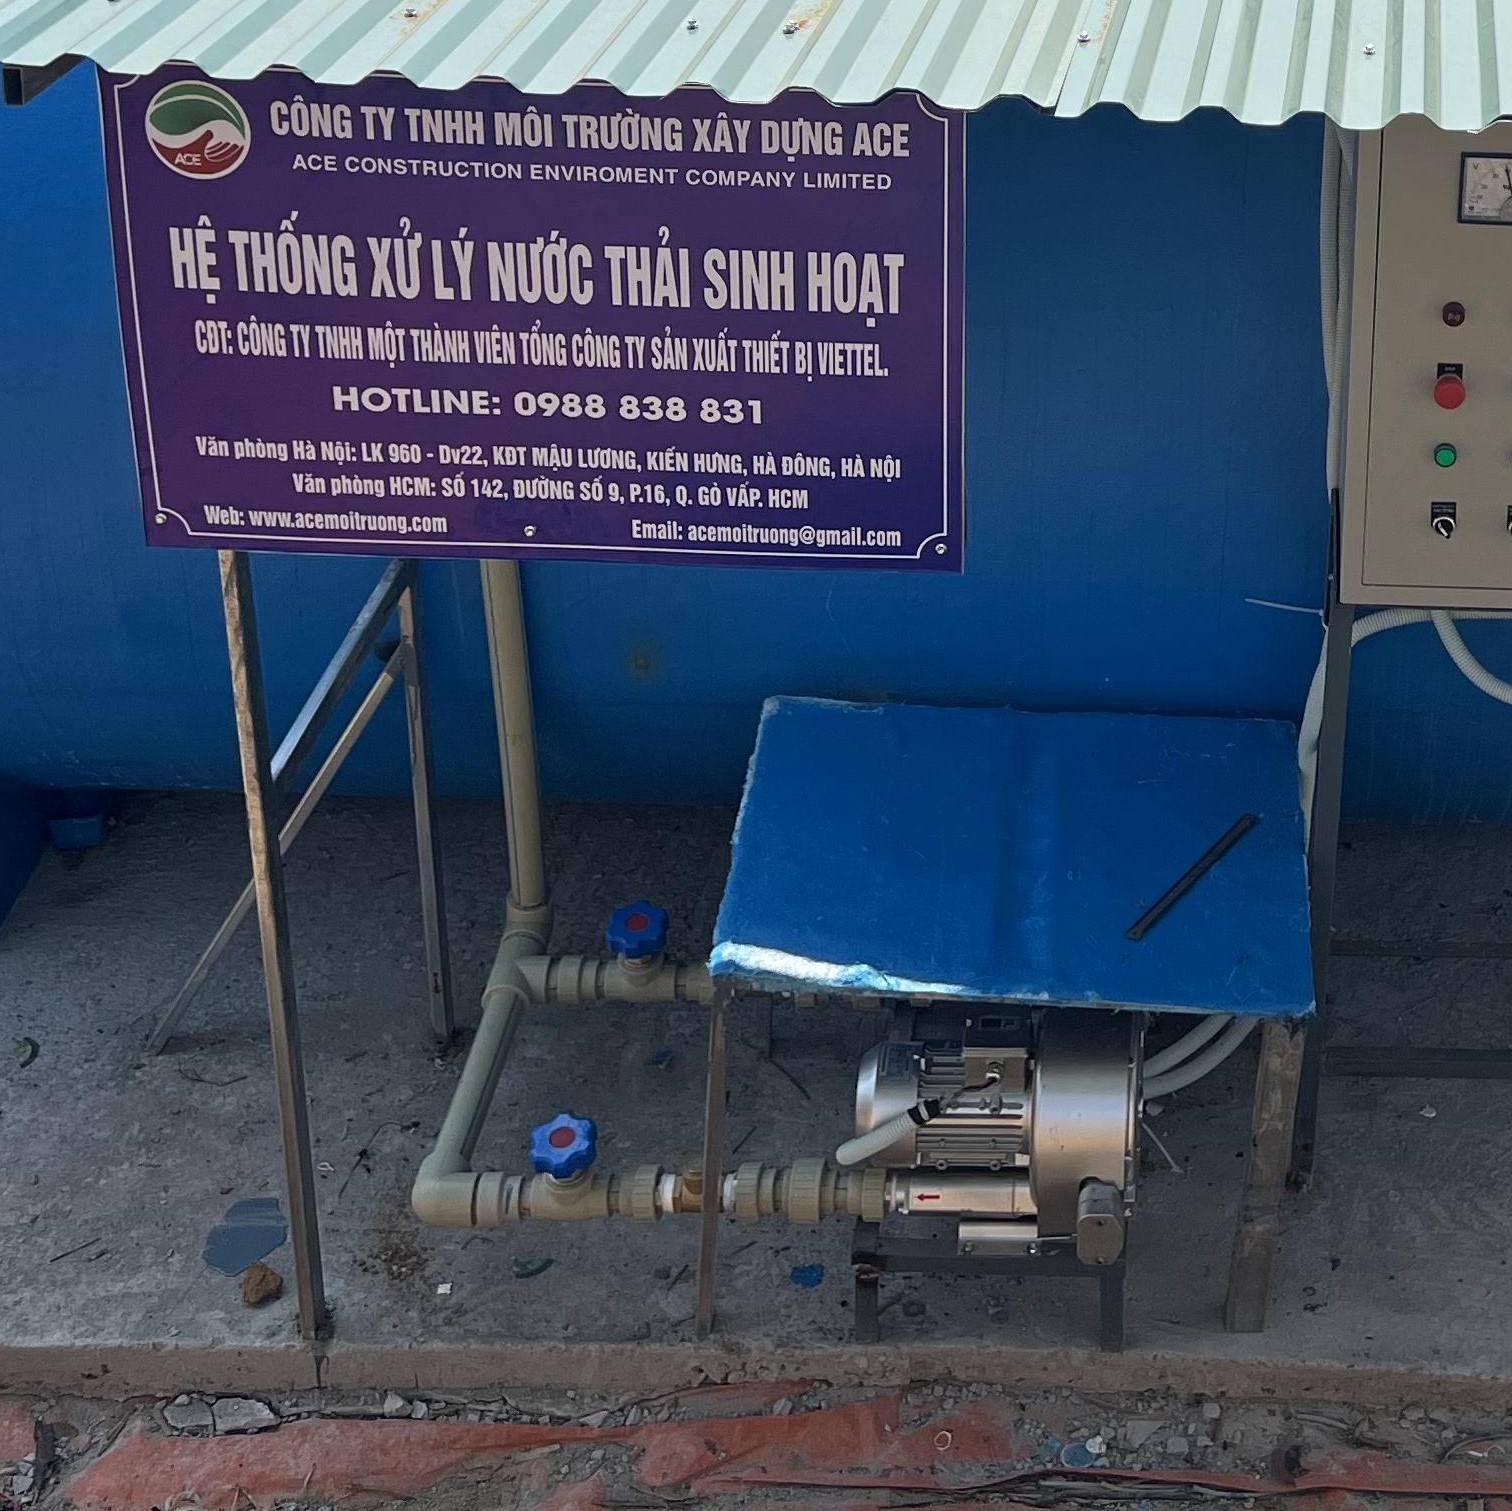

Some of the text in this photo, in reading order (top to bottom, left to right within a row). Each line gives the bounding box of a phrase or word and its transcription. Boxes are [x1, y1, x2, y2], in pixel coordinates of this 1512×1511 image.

[269, 94, 910, 162] CÔNG TY TNHH MÔI TRƯỜNG XÂY DỰNG ACE
[174, 151, 202, 167] ACE
[291, 153, 891, 190] ACE CONSTRUCTION ENVIROMENT COMPANY LIMITED
[168, 209, 904, 327] HỆ THỐNG XỬ LÝ NƯỚC THẢI SINH HOẠT
[194, 314, 889, 382] CĐT: CÔNG TY TNHH MỘT THÀNH VIÊN TỔNG CÔNG TY SẢN XUẤT THIẾT BỊ VIETTEL.
[331, 385, 761, 424] HOTLINE: 0988 838 831
[194, 435, 229, 457] Văn
[233, 437, 288, 462] phòng
[291, 439, 316, 461] Hà
[319, 440, 357, 466] Nội:
[360, 441, 384, 463] LK
[387, 442, 422, 464] 960
[437, 443, 488, 468] Dv22,
[492, 444, 527, 466] KĐT
[530, 442, 573, 472] MẬU
[576, 446, 642, 473] LƯƠNG,
[645, 445, 689, 472] KIẾN
[692, 450, 748, 477] HƯNG,
[751, 450, 778, 476] HÀ
[780, 451, 836, 480] ĐÔNG,
[840, 453, 865, 478] HÀ
[869, 453, 901, 483] NỘI
[291, 470, 809, 509] Văn phòng HCM: SỐ 142, ĐƯỜNG SỐ 9, P.16, Q. GÒ VẤP. HCM
[202, 504, 448, 534] Web: www.acemoitruong.com
[630, 518, 901, 547] Email: acemoitruong@gmail.com
